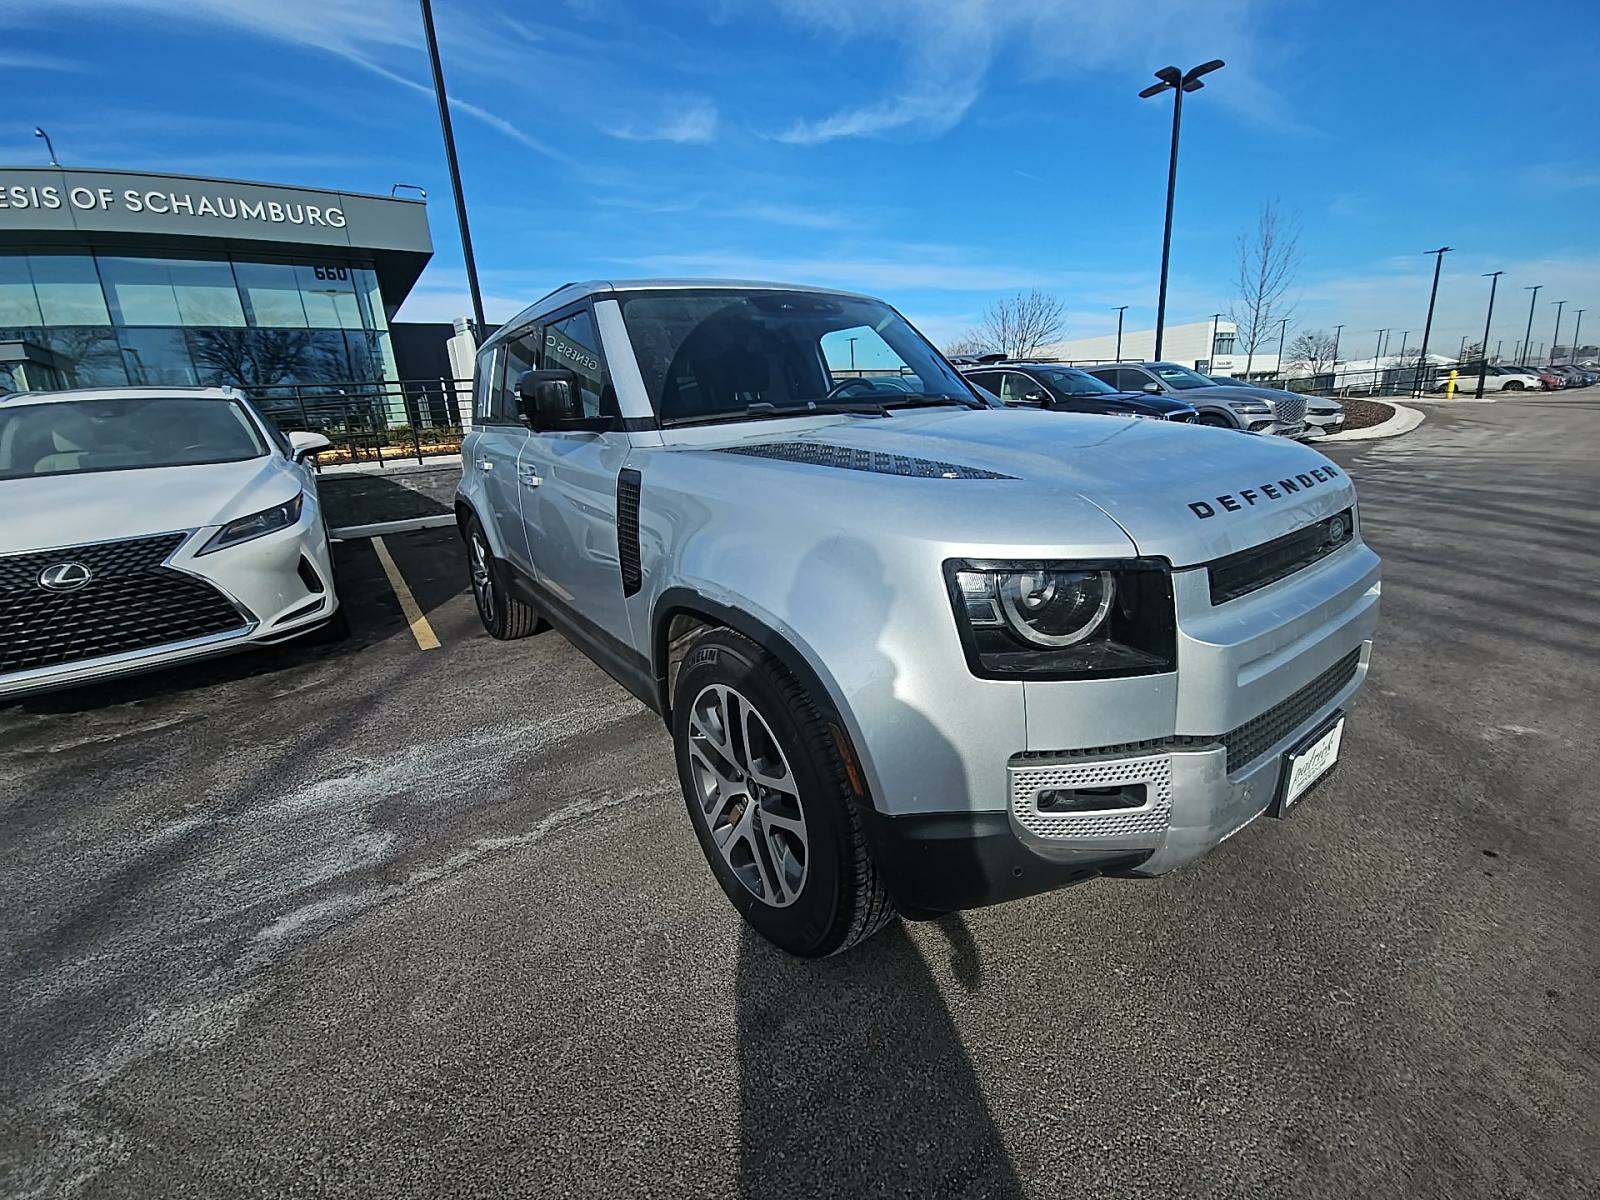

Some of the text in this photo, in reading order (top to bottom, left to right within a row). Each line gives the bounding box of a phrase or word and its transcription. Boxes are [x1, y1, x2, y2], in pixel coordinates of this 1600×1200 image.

[70, 187, 115, 211] OF
[124, 189, 347, 228] SCHAUMBURG
[314, 265, 348, 282] 660
[1187, 465, 1339, 520] DEFENDER
